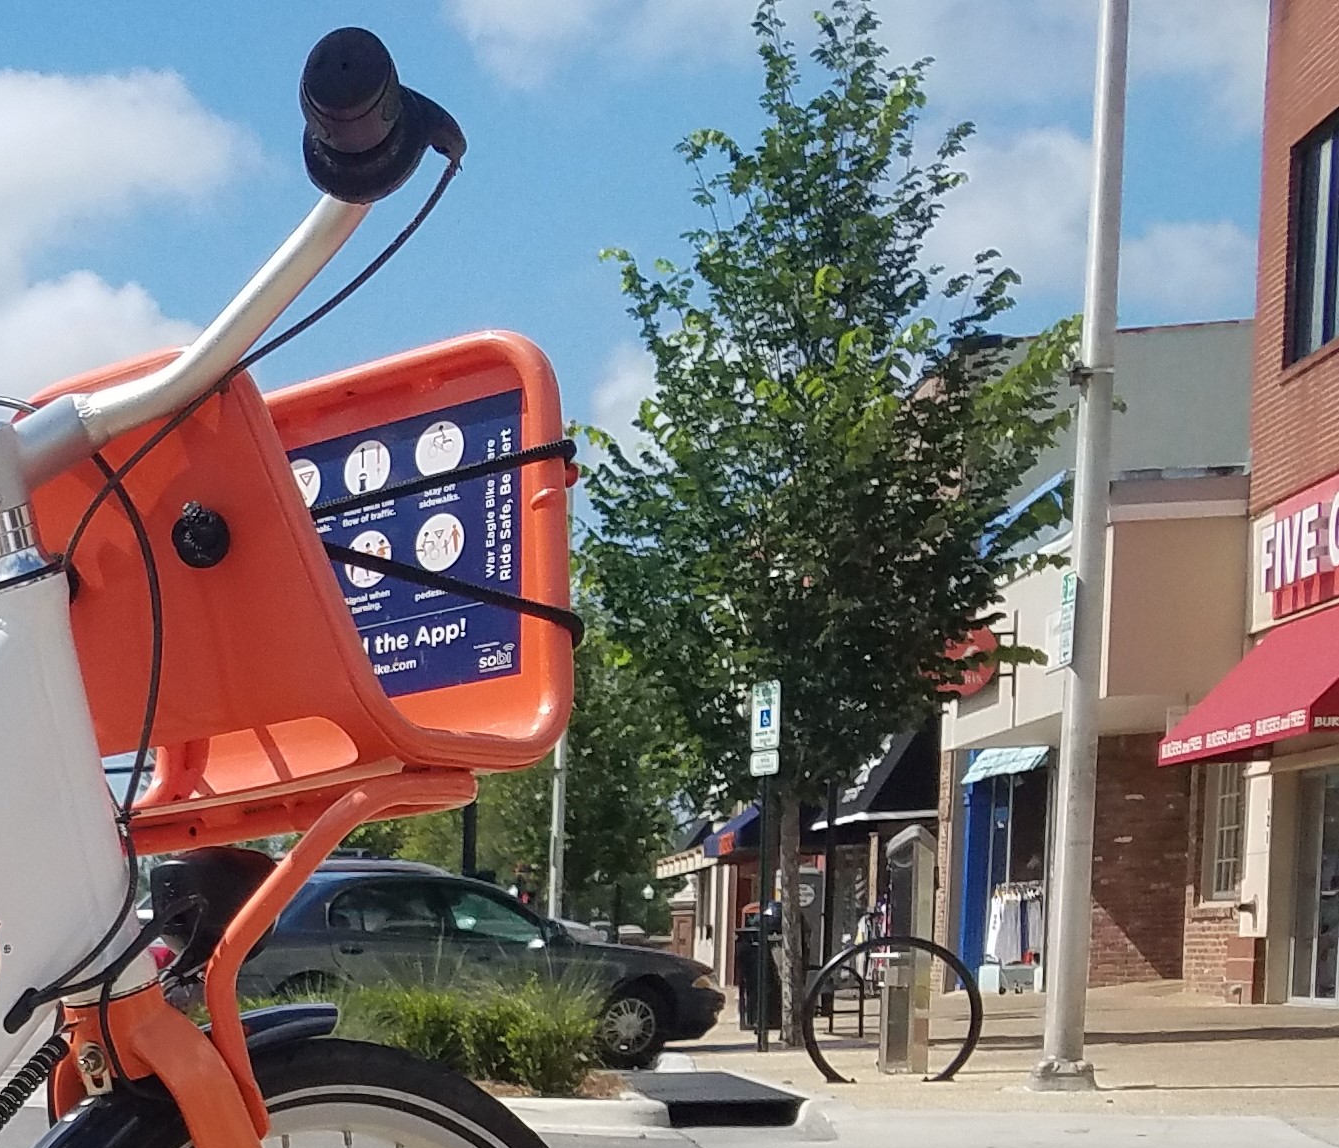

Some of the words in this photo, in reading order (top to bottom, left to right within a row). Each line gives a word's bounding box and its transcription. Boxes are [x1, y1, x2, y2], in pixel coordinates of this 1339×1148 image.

[485, 479, 496, 509] Bike
[499, 473, 512, 496] Be
[485, 510, 497, 548] Eagle
[499, 498, 514, 540] Safe,
[485, 551, 496, 579] War
[499, 543, 512, 581] Ride
[1261, 503, 1320, 593] FIVE
[375, 632, 410, 655] the
[415, 617, 467, 649] App!
[478, 649, 512, 669] sobi
